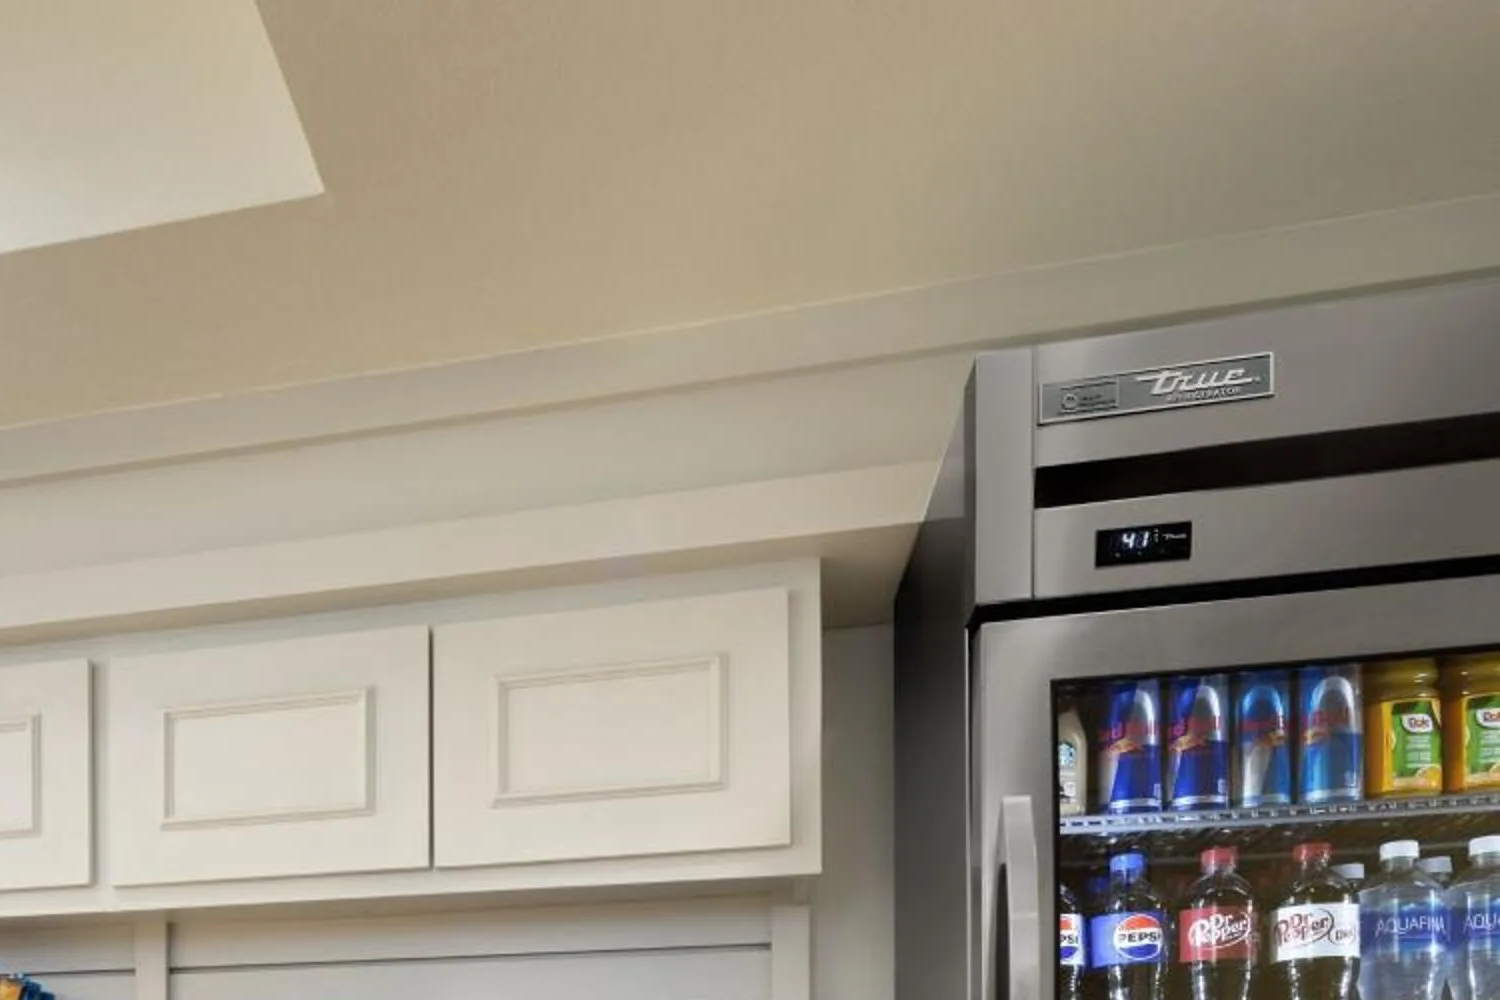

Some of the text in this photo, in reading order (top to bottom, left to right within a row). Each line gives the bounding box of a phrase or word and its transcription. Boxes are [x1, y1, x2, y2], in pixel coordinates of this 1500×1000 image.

[1136, 368, 1253, 396] True
[1213, 914, 1233, 929] Dr
[1376, 914, 1445, 936] AQUAFINA
[1118, 930, 1161, 944] PEPSI
[1189, 918, 1248, 948] Pepper
